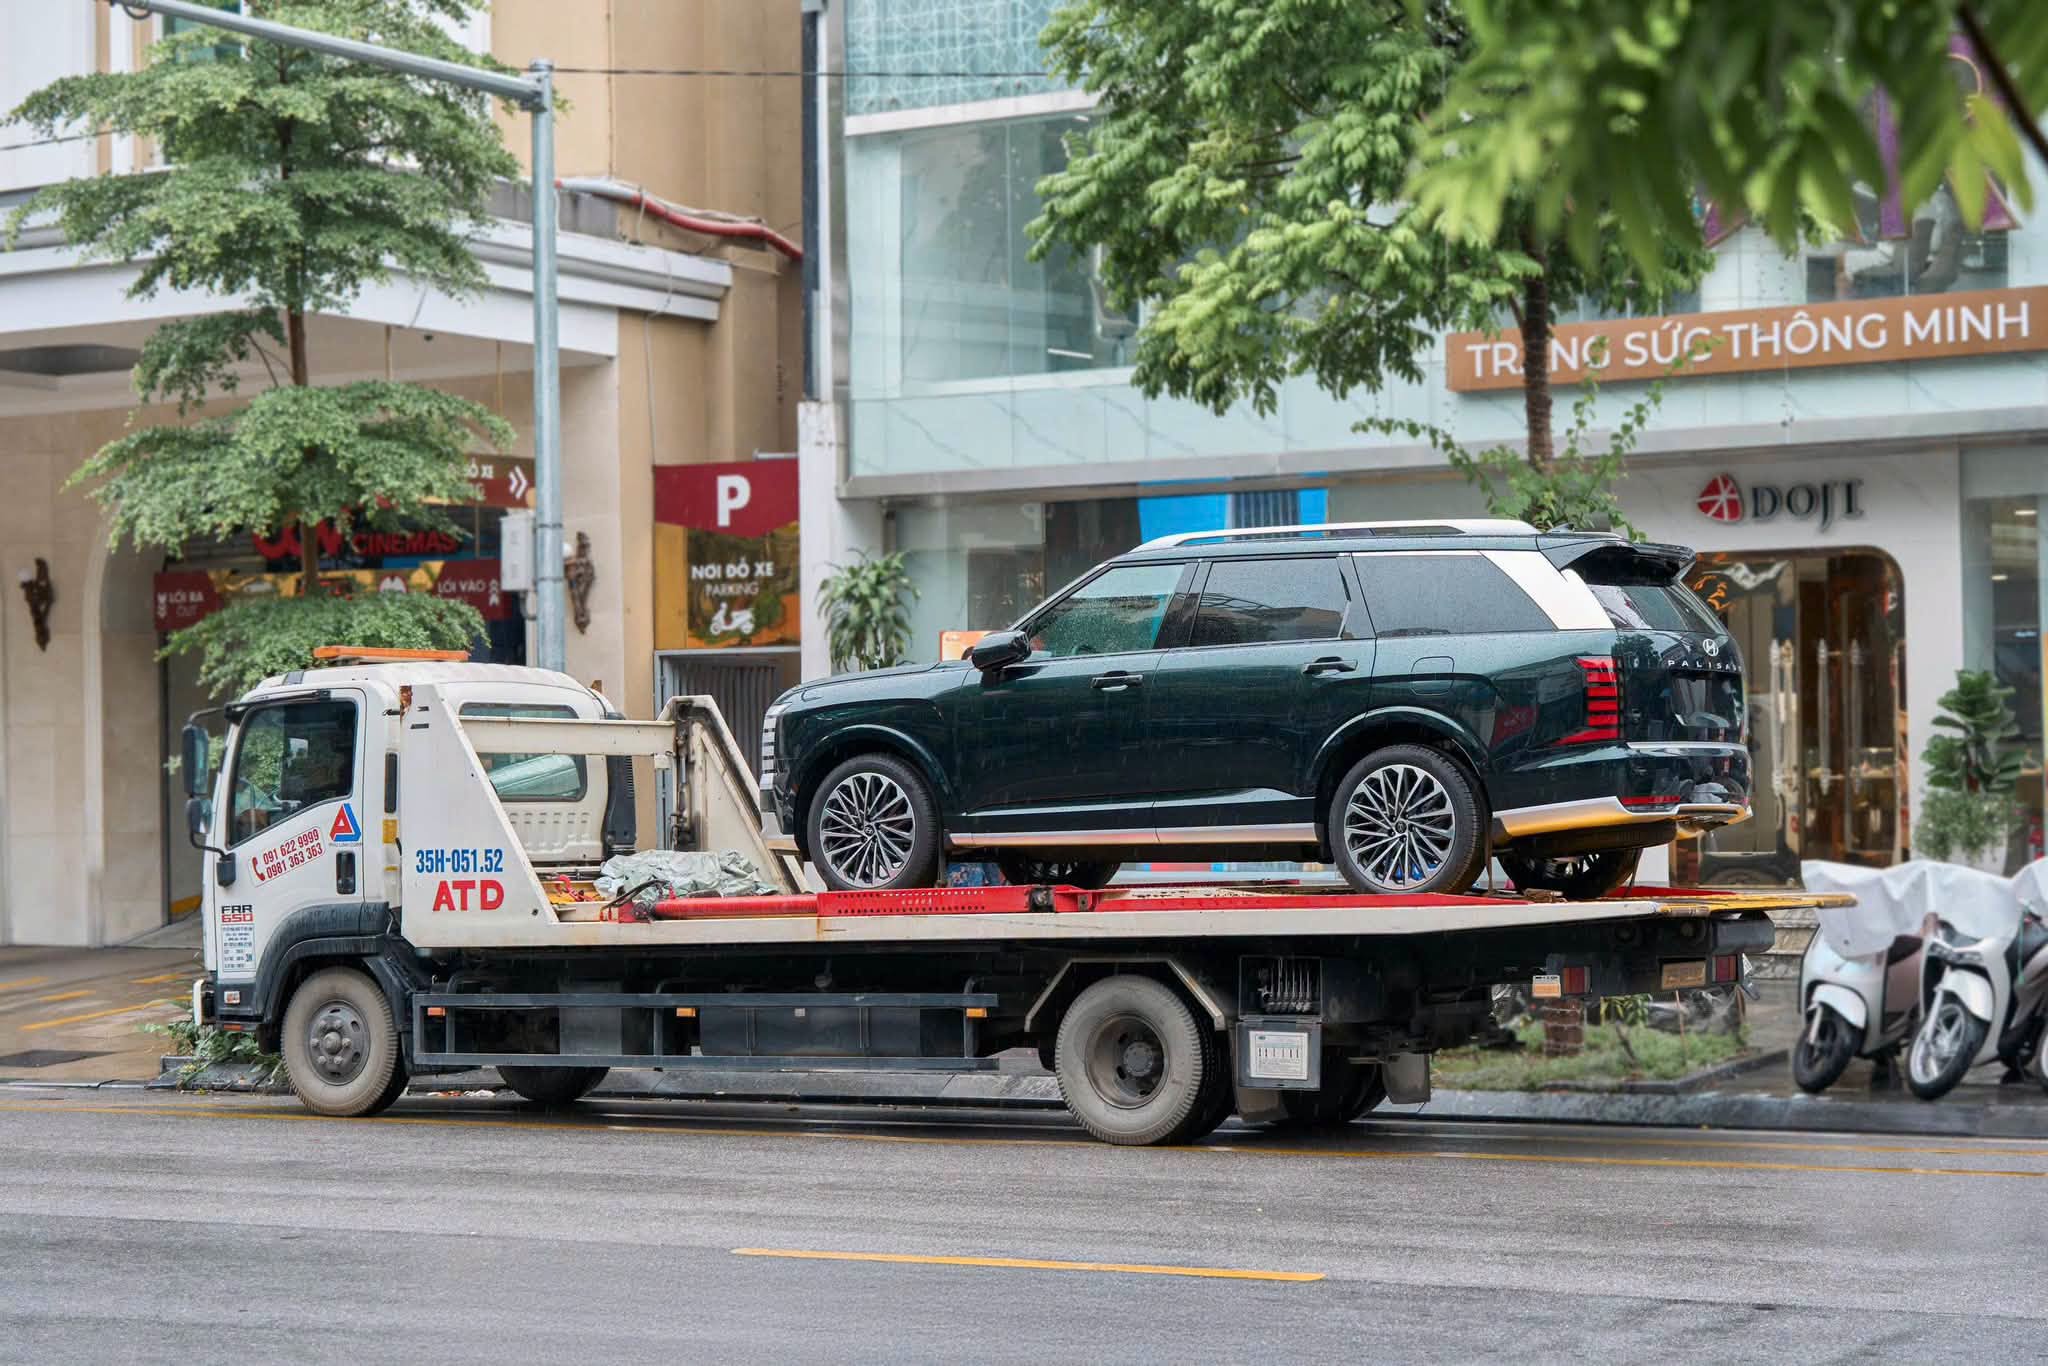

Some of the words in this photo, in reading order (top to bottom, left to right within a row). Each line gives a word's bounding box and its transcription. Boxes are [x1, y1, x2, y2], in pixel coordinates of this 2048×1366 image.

[1466, 335, 1611, 378] TRNG
[1624, 320, 1712, 367] SỨC
[1722, 311, 1888, 358] THÔNG
[1904, 301, 2030, 346] MINH
[716, 474, 751, 527] P
[1751, 479, 1865, 534] DOJI
[352, 530, 459, 556] CINEMAS
[754, 561, 774, 576] XE
[704, 582, 759, 596] PARKING
[263, 848, 279, 865] 091
[280, 839, 297, 857] 622
[297, 828, 320, 847] 9999
[266, 861, 288, 879] 0981
[289, 850, 306, 868] 363
[306, 842, 324, 859] 363
[415, 848, 504, 873] 35H-051.52
[432, 879, 504, 912] ATD
